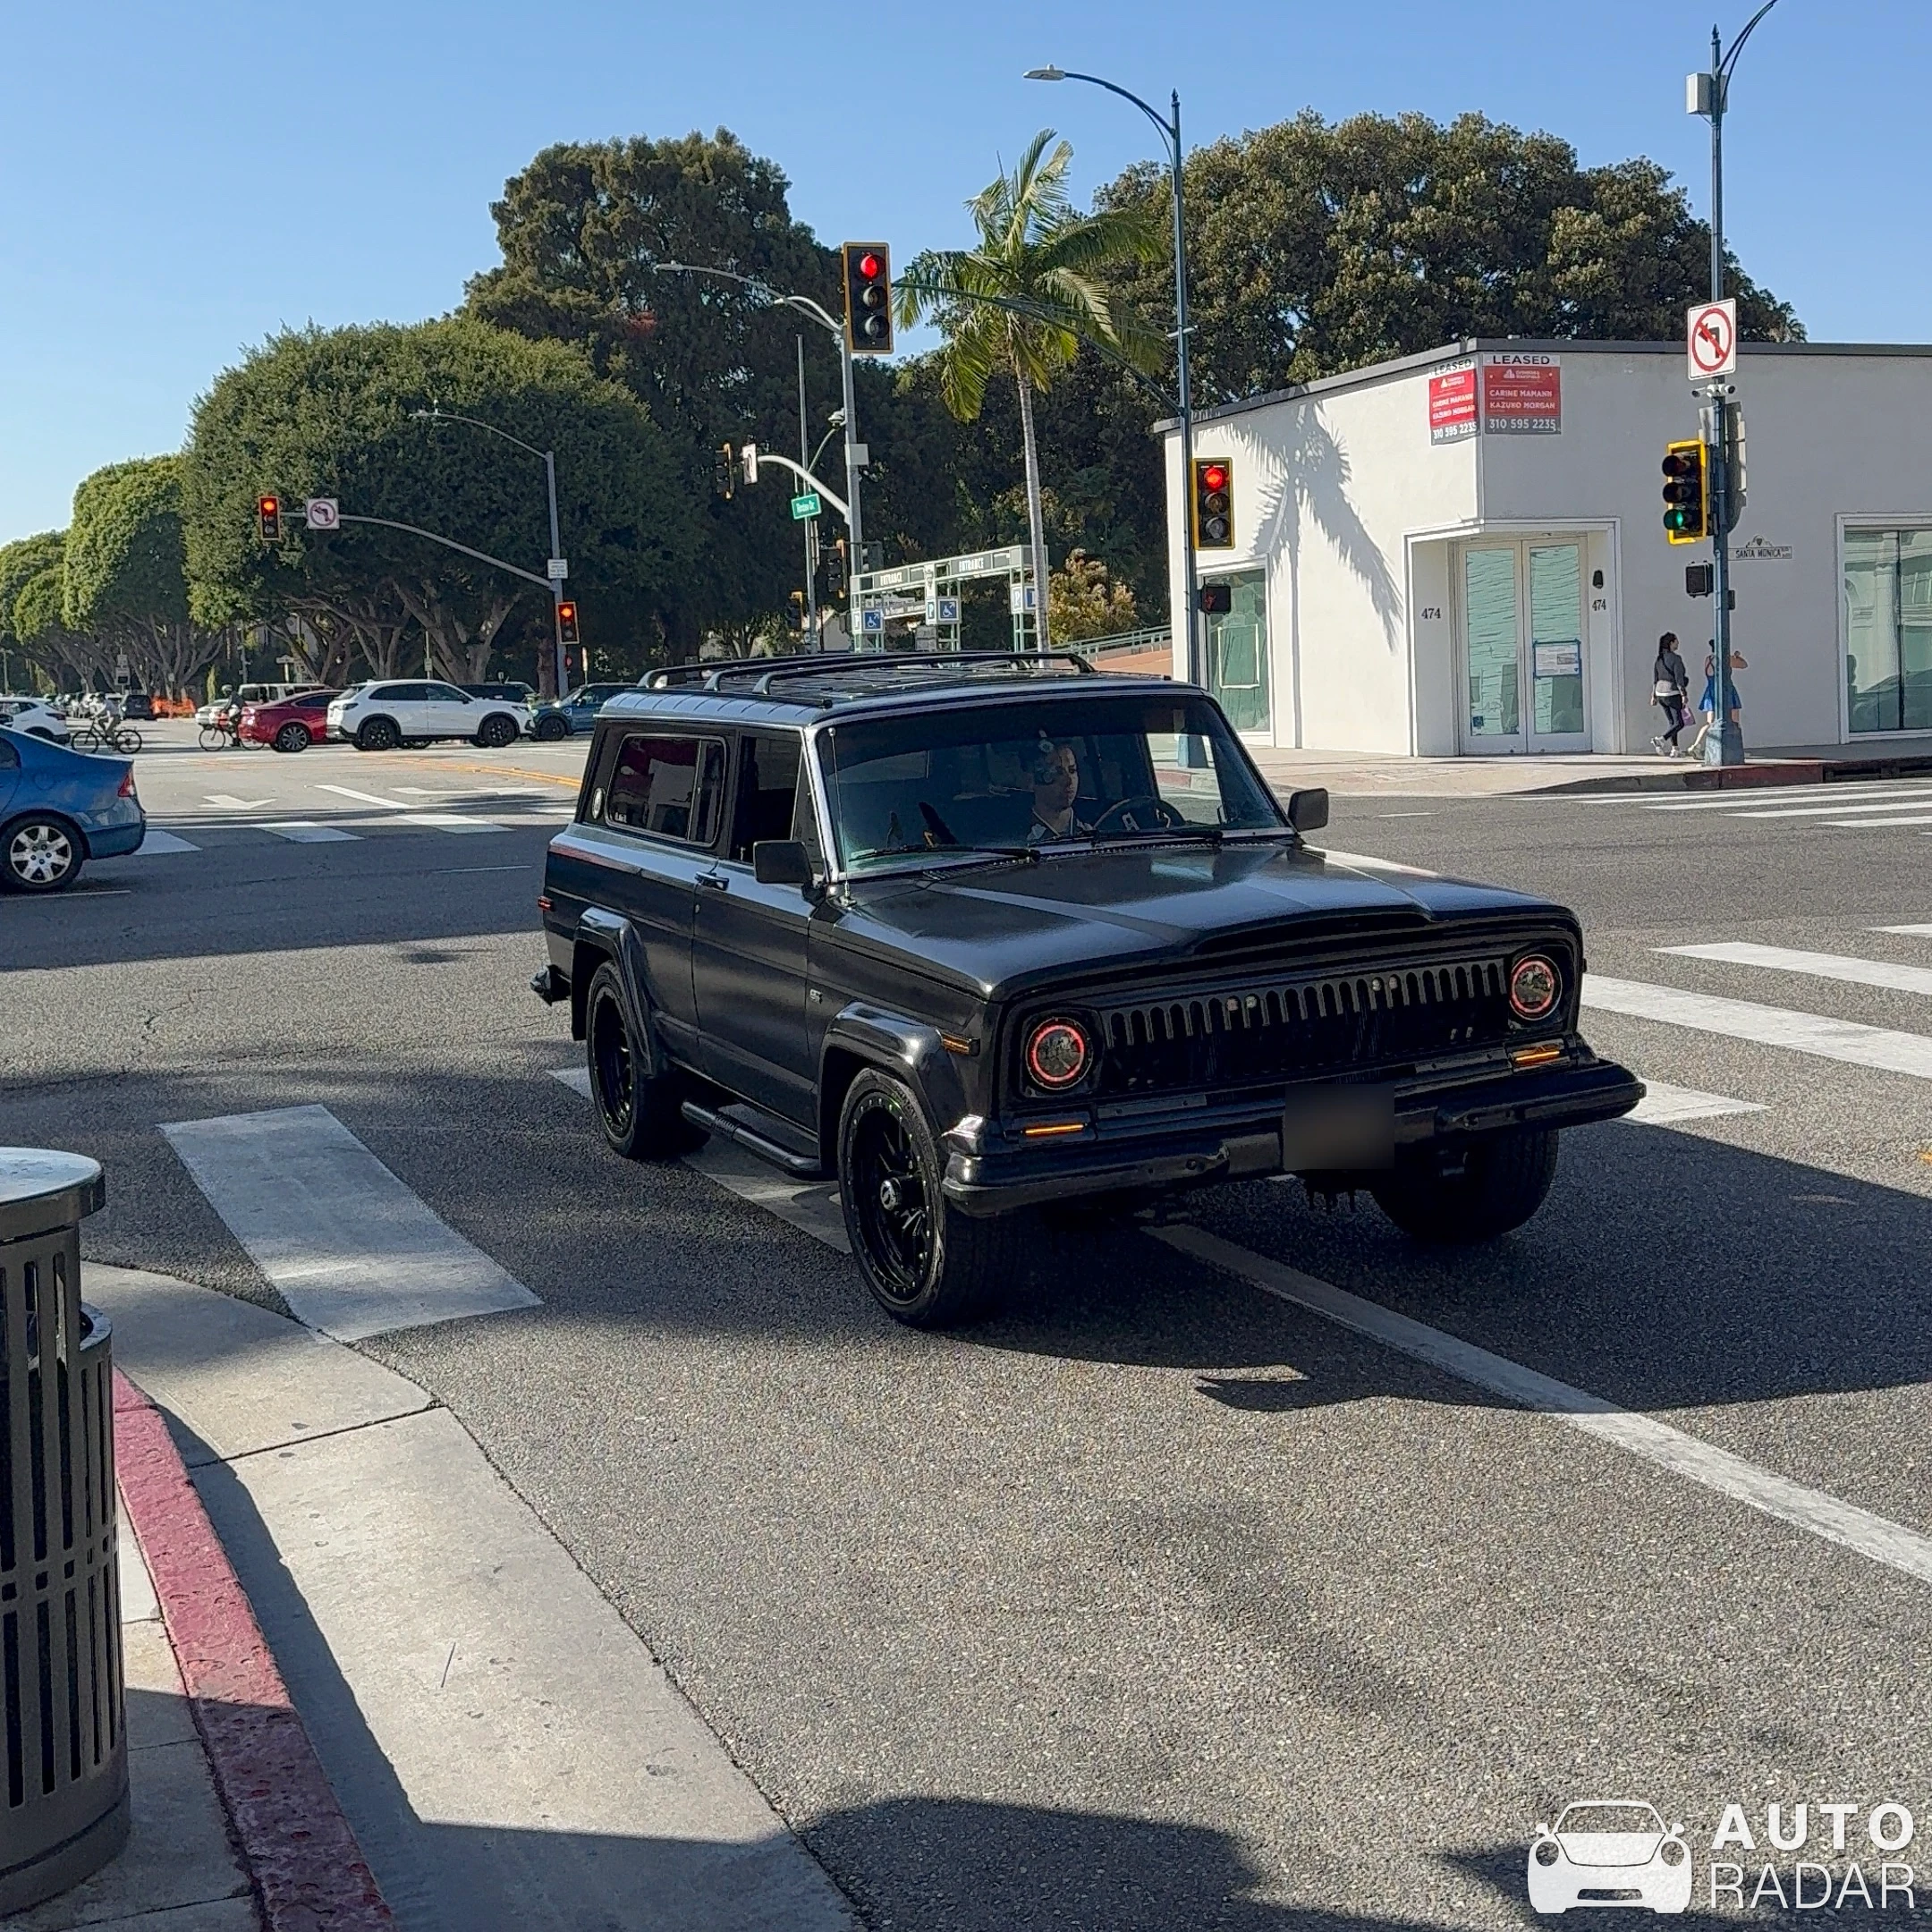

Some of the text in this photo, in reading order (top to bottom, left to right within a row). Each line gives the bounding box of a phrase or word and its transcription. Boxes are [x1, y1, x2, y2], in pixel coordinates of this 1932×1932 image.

[1493, 355, 1550, 365] LEASED
[1435, 359, 1471, 376] LEASED
[1459, 420, 1477, 434] 2235
[1489, 419, 1556, 429] 310 595 2235
[1735, 550, 1755, 559] SANTA
[1758, 549, 1781, 558] MONICA
[958, 557, 984, 572] ENTRANCE
[928, 603, 934, 617] P
[1592, 599, 1606, 611] 474
[1421, 607, 1441, 619] 474
